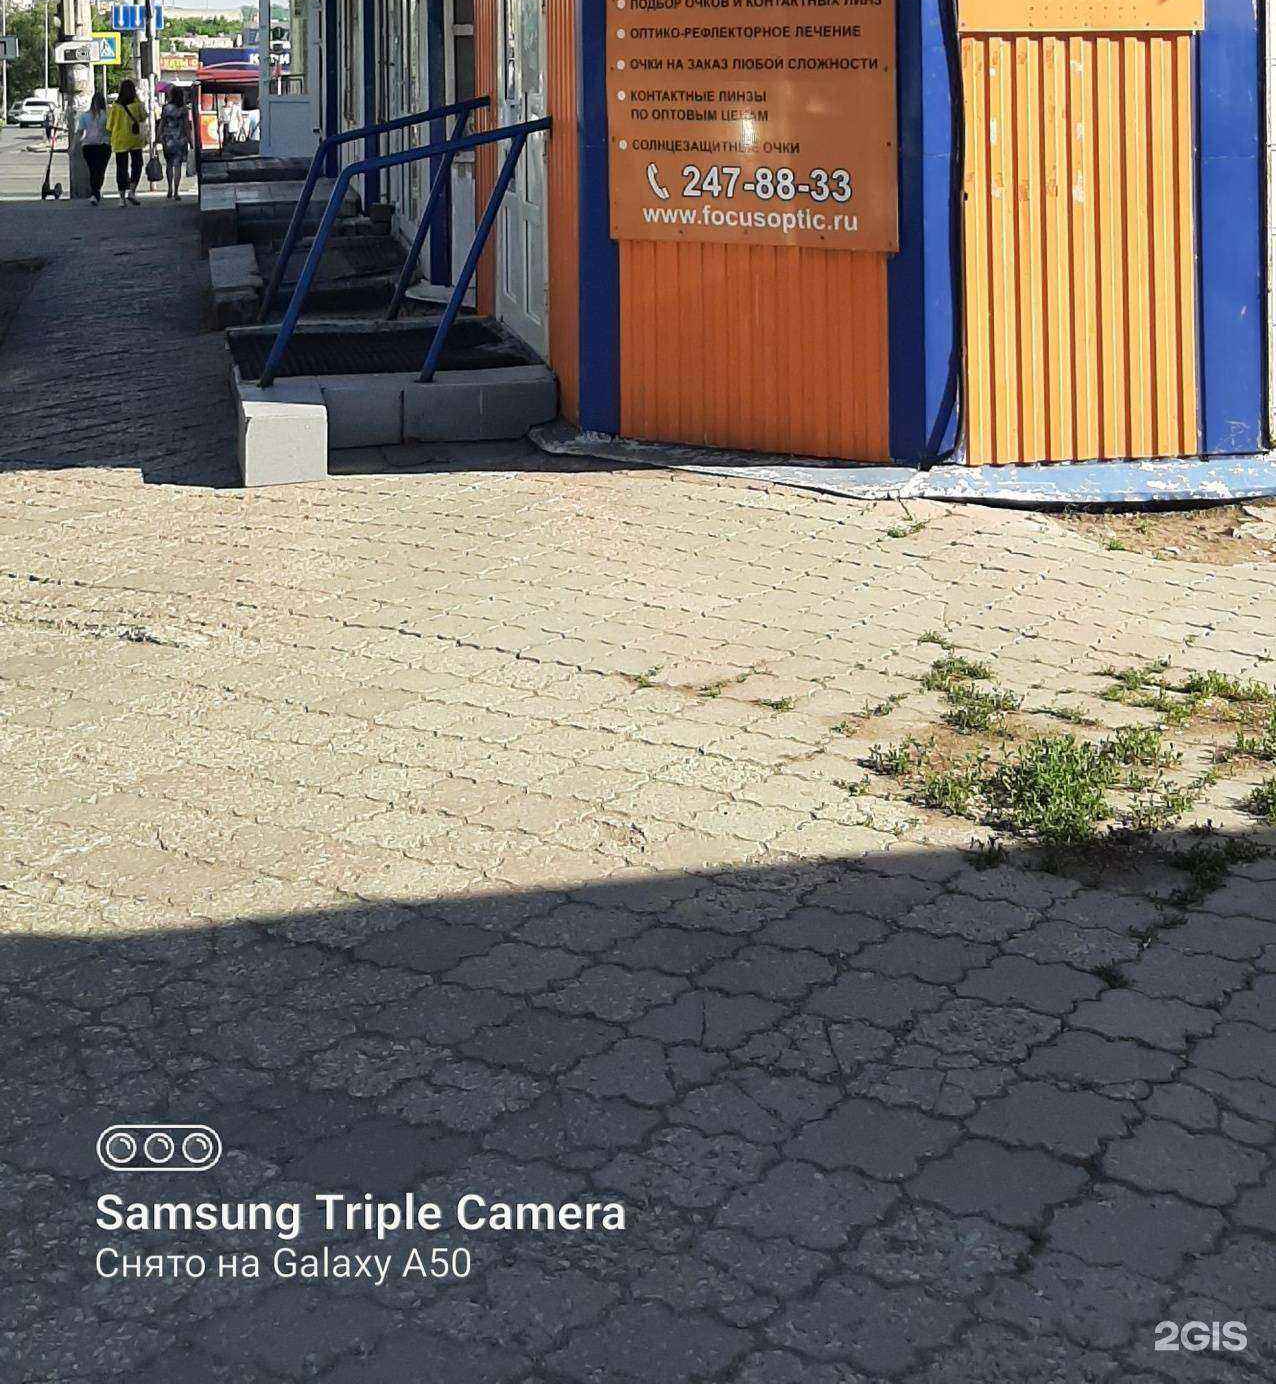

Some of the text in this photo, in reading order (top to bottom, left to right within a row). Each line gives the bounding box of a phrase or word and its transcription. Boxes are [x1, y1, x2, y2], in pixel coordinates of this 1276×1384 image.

[630, 24, 861, 39] ОПТИКО-РЕФЛЕКТОРНОЕ ЛЕЧЕНИЕ
[630, 55, 878, 71] ОЧКИ НА ЗАКАЗ ЛЮБОЙ СЛОЖНОСТИ
[630, 90, 767, 103] КОНТАКТНЫЕ ЛИНЗЫ
[630, 109, 648, 121] ПО
[652, 109, 717, 122] ОПТОВЫМ
[763, 143, 800, 154] ОЧКИ
[682, 165, 852, 202] 247-88-33
[642, 205, 859, 233] www.focusoptic.ru
